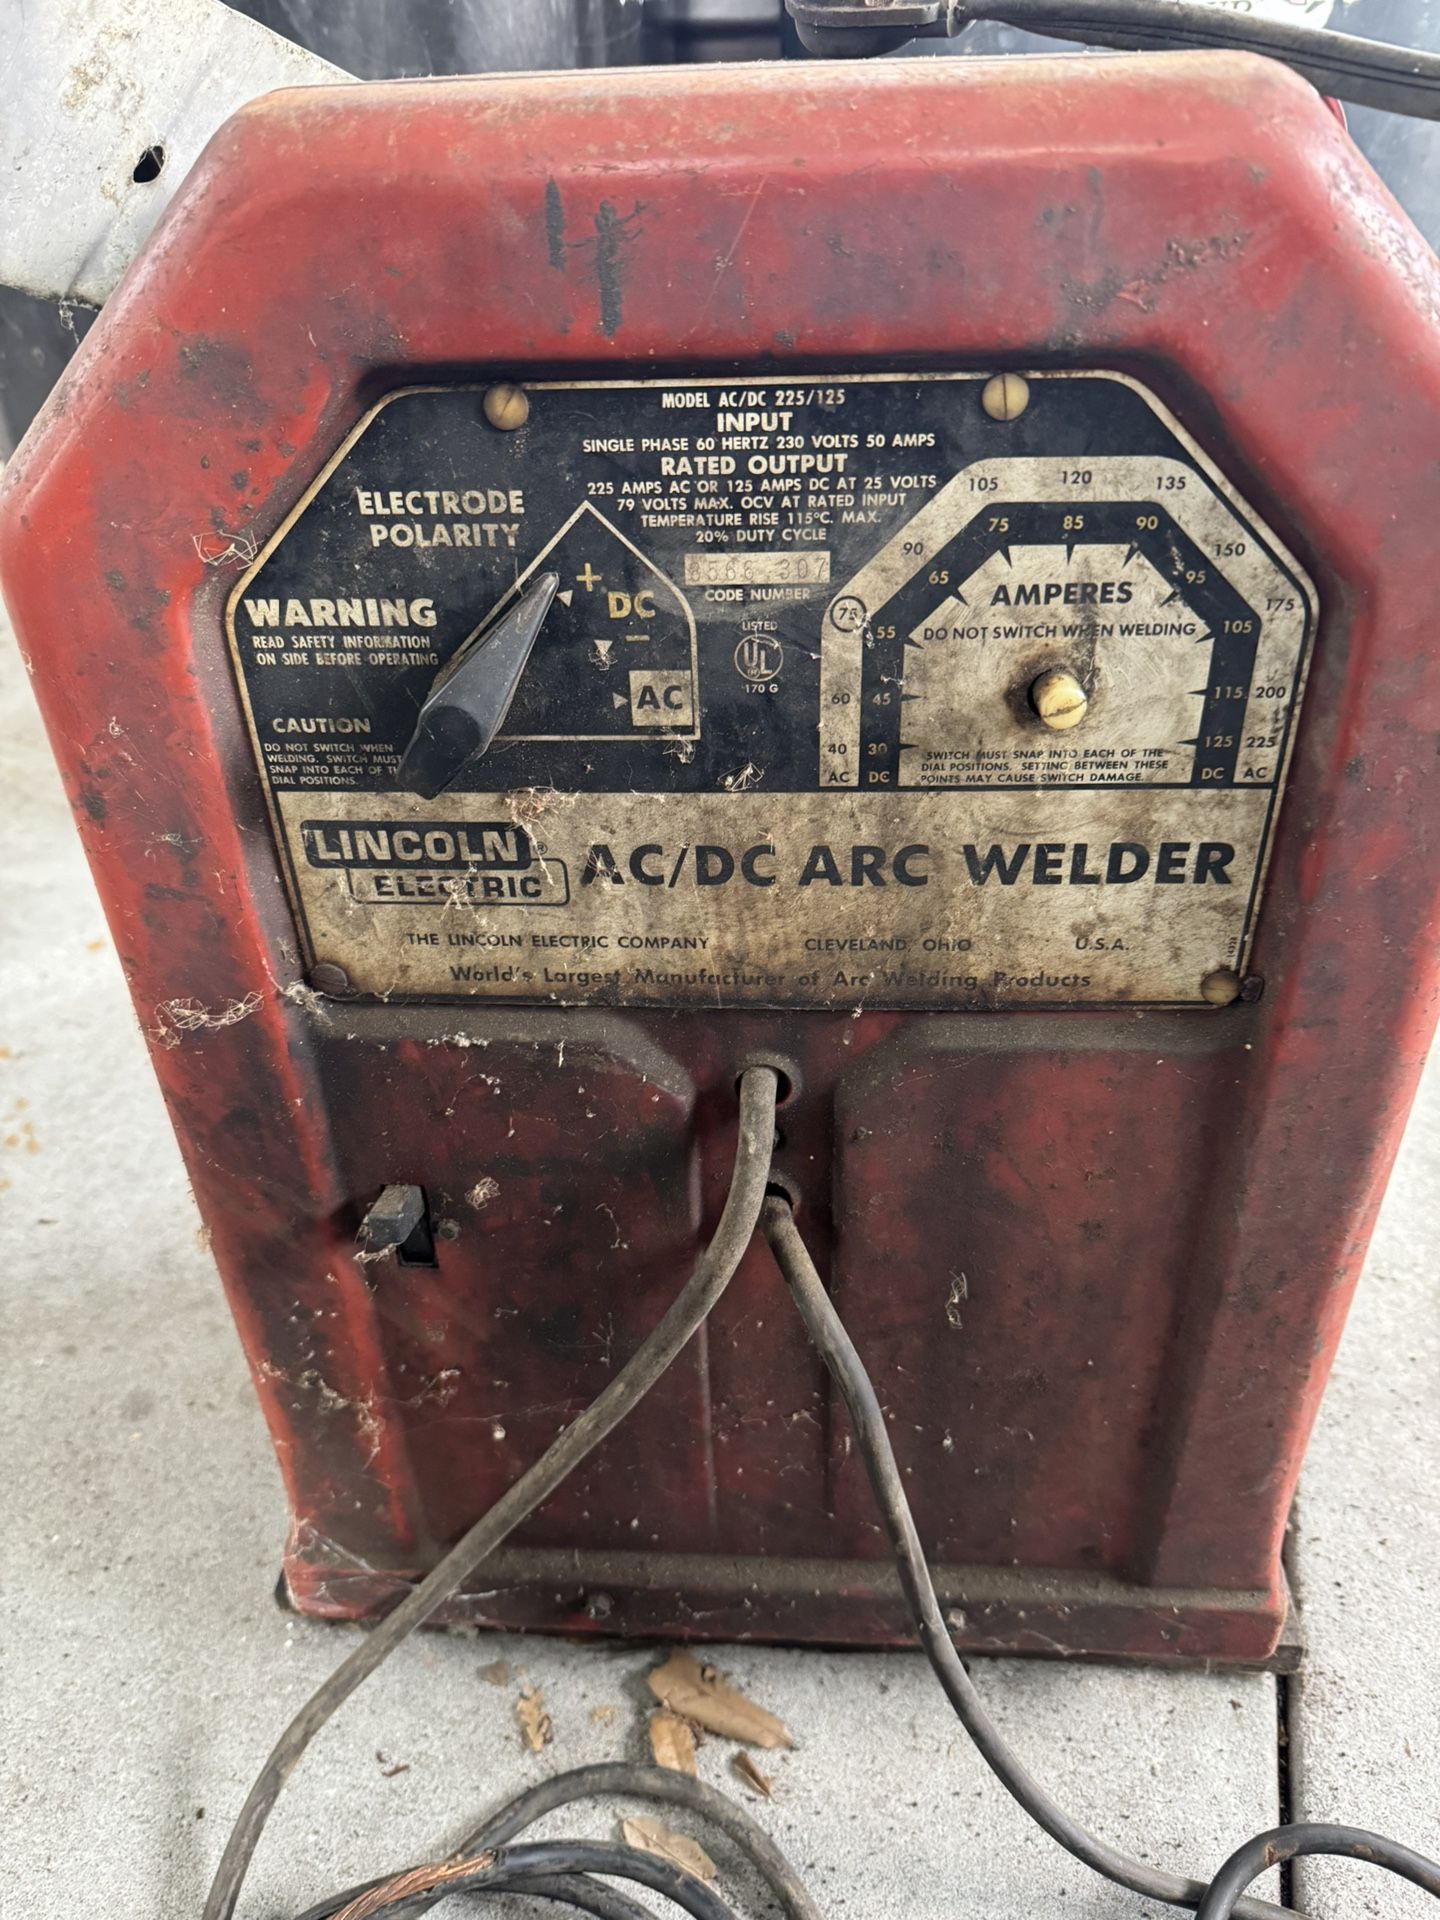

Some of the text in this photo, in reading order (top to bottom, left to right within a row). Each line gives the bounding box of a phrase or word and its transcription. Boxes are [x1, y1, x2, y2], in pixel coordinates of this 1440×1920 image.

[662, 389, 845, 408] MODEL AC/DC 225/125
[717, 412, 793, 432] INPUT
[583, 434, 935, 453] SINGLE PHASE 60 HERTZ 230 VOLTS 50 AMPS
[661, 453, 848, 476] RATED OUTPUT
[588, 475, 936, 495] 225 AMPS AC OR 125 AMPS DC AT 25 VOLTS
[969, 471, 1186, 492] 105 120 135
[357, 490, 525, 515] ELECTRODE
[617, 493, 906, 512] 79 VOLTS MAX. OCV AT RATED INPUT
[641, 513, 741, 528] TEMPERATURE
[750, 512, 779, 525] RISE
[988, 516, 1158, 532] 75 85 90
[370, 523, 520, 548] POLARITY
[696, 528, 827, 543] 20% DUTY CYCLE
[904, 542, 923, 555] 90
[1215, 543, 1245, 557] 150
[928, 571, 949, 584] 65
[1186, 571, 1205, 584] 95
[705, 589, 811, 601] CODE NUMBER
[990, 582, 1133, 606] AMPERES
[608, 590, 656, 619] DC
[1266, 599, 1295, 612] 175
[244, 599, 437, 627] WARNING
[839, 608, 857, 620] 75
[742, 621, 778, 631] LISTED
[876, 626, 896, 639] 55
[924, 623, 1196, 640] DO NOT SWITCH WHEN WELDING
[1222, 621, 1252, 634] 105
[252, 635, 430, 648] READ SAFETY INFORMATION
[257, 652, 439, 666] ON SIDE BEFORE OPERATING
[746, 684, 778, 693] 170 G
[1256, 686, 1286, 698] 200
[637, 685, 683, 710] AC
[832, 693, 850, 704] 60
[872, 693, 891, 705] 45
[272, 718, 371, 733] CAUTION
[264, 743, 393, 752] DO NOT SWITCH WHEN
[1205, 736, 1232, 748] 125
[1246, 736, 1277, 748] 225
[828, 744, 847, 755] 40
[868, 743, 887, 756] 30
[926, 748, 1163, 761] SWITCH MUST SNAP INTO EACH OF THE
[267, 755, 319, 763] WELDING.
[326, 755, 368, 763] SWITCH
[921, 763, 945, 771] DIAL
[1021, 762, 1068, 770] SETTING
[1075, 761, 1128, 770] BETWEEN
[1134, 760, 1168, 769] THESE
[270, 765, 298, 774] SNAP
[303, 765, 329, 774] INTO
[334, 766, 363, 774] EACH
[368, 766, 382, 774] OF
[1202, 768, 1224, 779] DC
[1244, 767, 1268, 778] AC
[272, 776, 295, 784] DIAL
[828, 772, 849, 783] AC
[869, 771, 890, 783] DC
[921, 772, 1144, 783] POINTS MAY CAUSE SWITCH DAMAGE.
[312, 830, 519, 862] LINCOLN
[581, 841, 1236, 888] AC/DC ARC WELDER
[374, 876, 542, 897] ELECTRIC
[407, 933, 710, 949] THE LINCOLN ELECTRIC COMPANY
[923, 939, 971, 951] OHIO
[1075, 937, 1129, 950] U.S.A.
[451, 966, 1090, 991] World's Largest Manufacturer of Arc Welding Products
